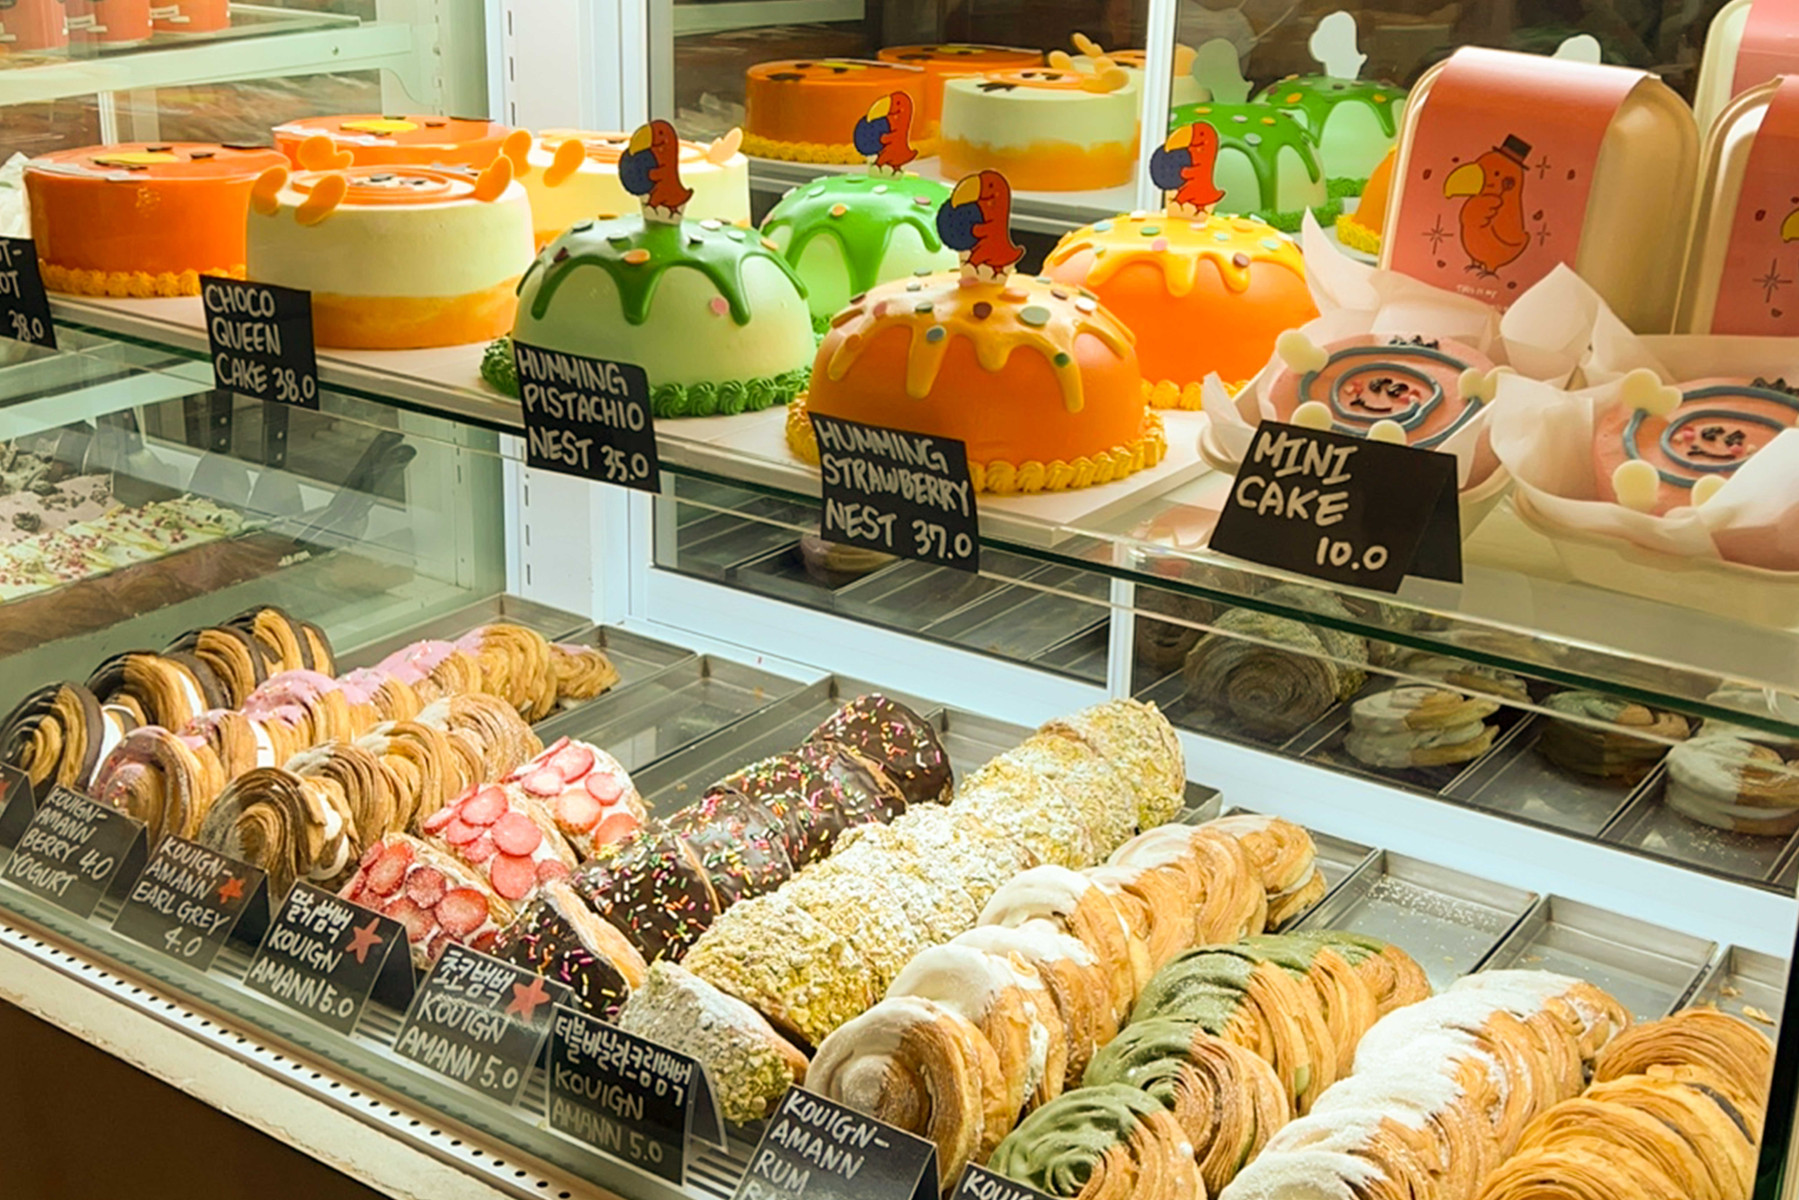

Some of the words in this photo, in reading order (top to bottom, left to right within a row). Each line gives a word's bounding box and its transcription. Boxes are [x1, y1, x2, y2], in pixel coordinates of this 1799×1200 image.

[8, 309, 44, 341] 38.0
[205, 284, 275, 318] CHOCO
[212, 317, 281, 356] QUEEN
[216, 352, 267, 393] CAKE
[272, 367, 315, 403] 38.0
[516, 348, 628, 397] HUMMING
[523, 383, 645, 432] PISTACHIO
[529, 426, 593, 470] NEST
[601, 445, 649, 482] 35.0
[815, 419, 949, 475] HUMMING
[1253, 431, 1359, 485] MINI
[822, 453, 969, 518] STRAWBERRY
[1235, 475, 1349, 527] CAKE
[825, 498, 897, 548] NEST
[912, 519, 973, 559] 37.0
[1316, 536, 1389, 571] 10.0
[35, 807, 98, 844] AMANN
[47, 787, 108, 823] KOUIGN-
[8, 852, 78, 897] YOGURT
[22, 828, 80, 863] BERRY
[79, 848, 114, 880] 4.0
[145, 856, 218, 900] AMANN
[159, 836, 233, 878] KOUIGN-
[131, 881, 174, 914] EARL
[176, 900, 231, 936] GREY
[164, 926, 203, 957] 4.0
[268, 923, 344, 973] KOUIGN
[250, 956, 326, 1008] AMANN
[318, 983, 355, 1019] 5.0
[416, 990, 511, 1044] KOUIGN
[397, 1025, 482, 1082] AMANN
[479, 1055, 519, 1089] 5.0
[555, 1062, 644, 1121] KOUIGN
[552, 1097, 621, 1151] AMANN
[629, 1131, 663, 1164] 5.0
[782, 1090, 890, 1149] KOUIGN-
[753, 1149, 810, 1195] RUM
[769, 1119, 865, 1180] AMANN
